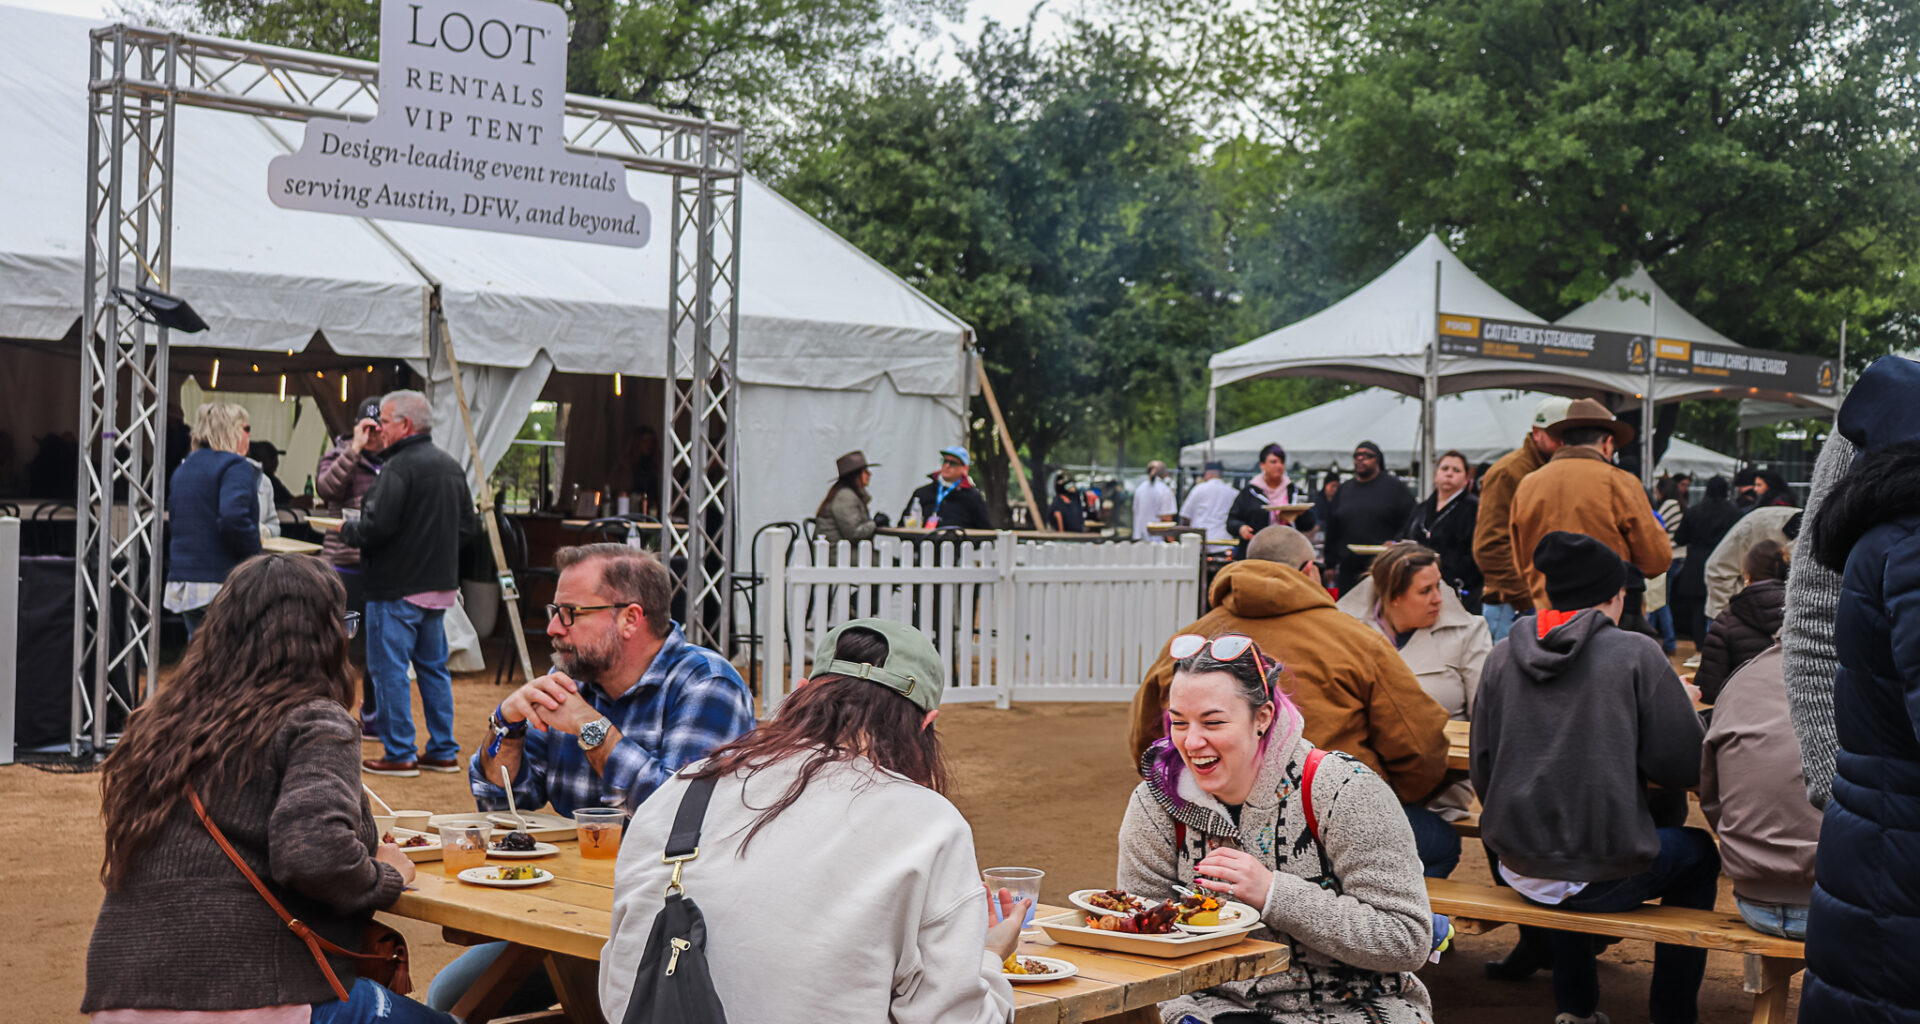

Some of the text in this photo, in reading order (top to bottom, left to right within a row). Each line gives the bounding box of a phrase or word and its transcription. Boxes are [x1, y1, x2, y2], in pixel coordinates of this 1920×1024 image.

[408, 4, 546, 65] LOOT
[405, 67, 544, 108] RENTALS
[404, 106, 544, 145] VIP TENT
[320, 132, 616, 193] Design-leading event rentals
[284, 178, 641, 236] serving Austin, DFW, and beyond.
[1445, 320, 1472, 332] FOOD
[1483, 323, 1544, 345] CATTLEMEN'S
[1544, 330, 1595, 351] STEAKHOUSE
[1693, 349, 1726, 369] WILLIAM
[1726, 353, 1748, 371] CHRIS
[1748, 356, 1788, 376] VINEYARDS
